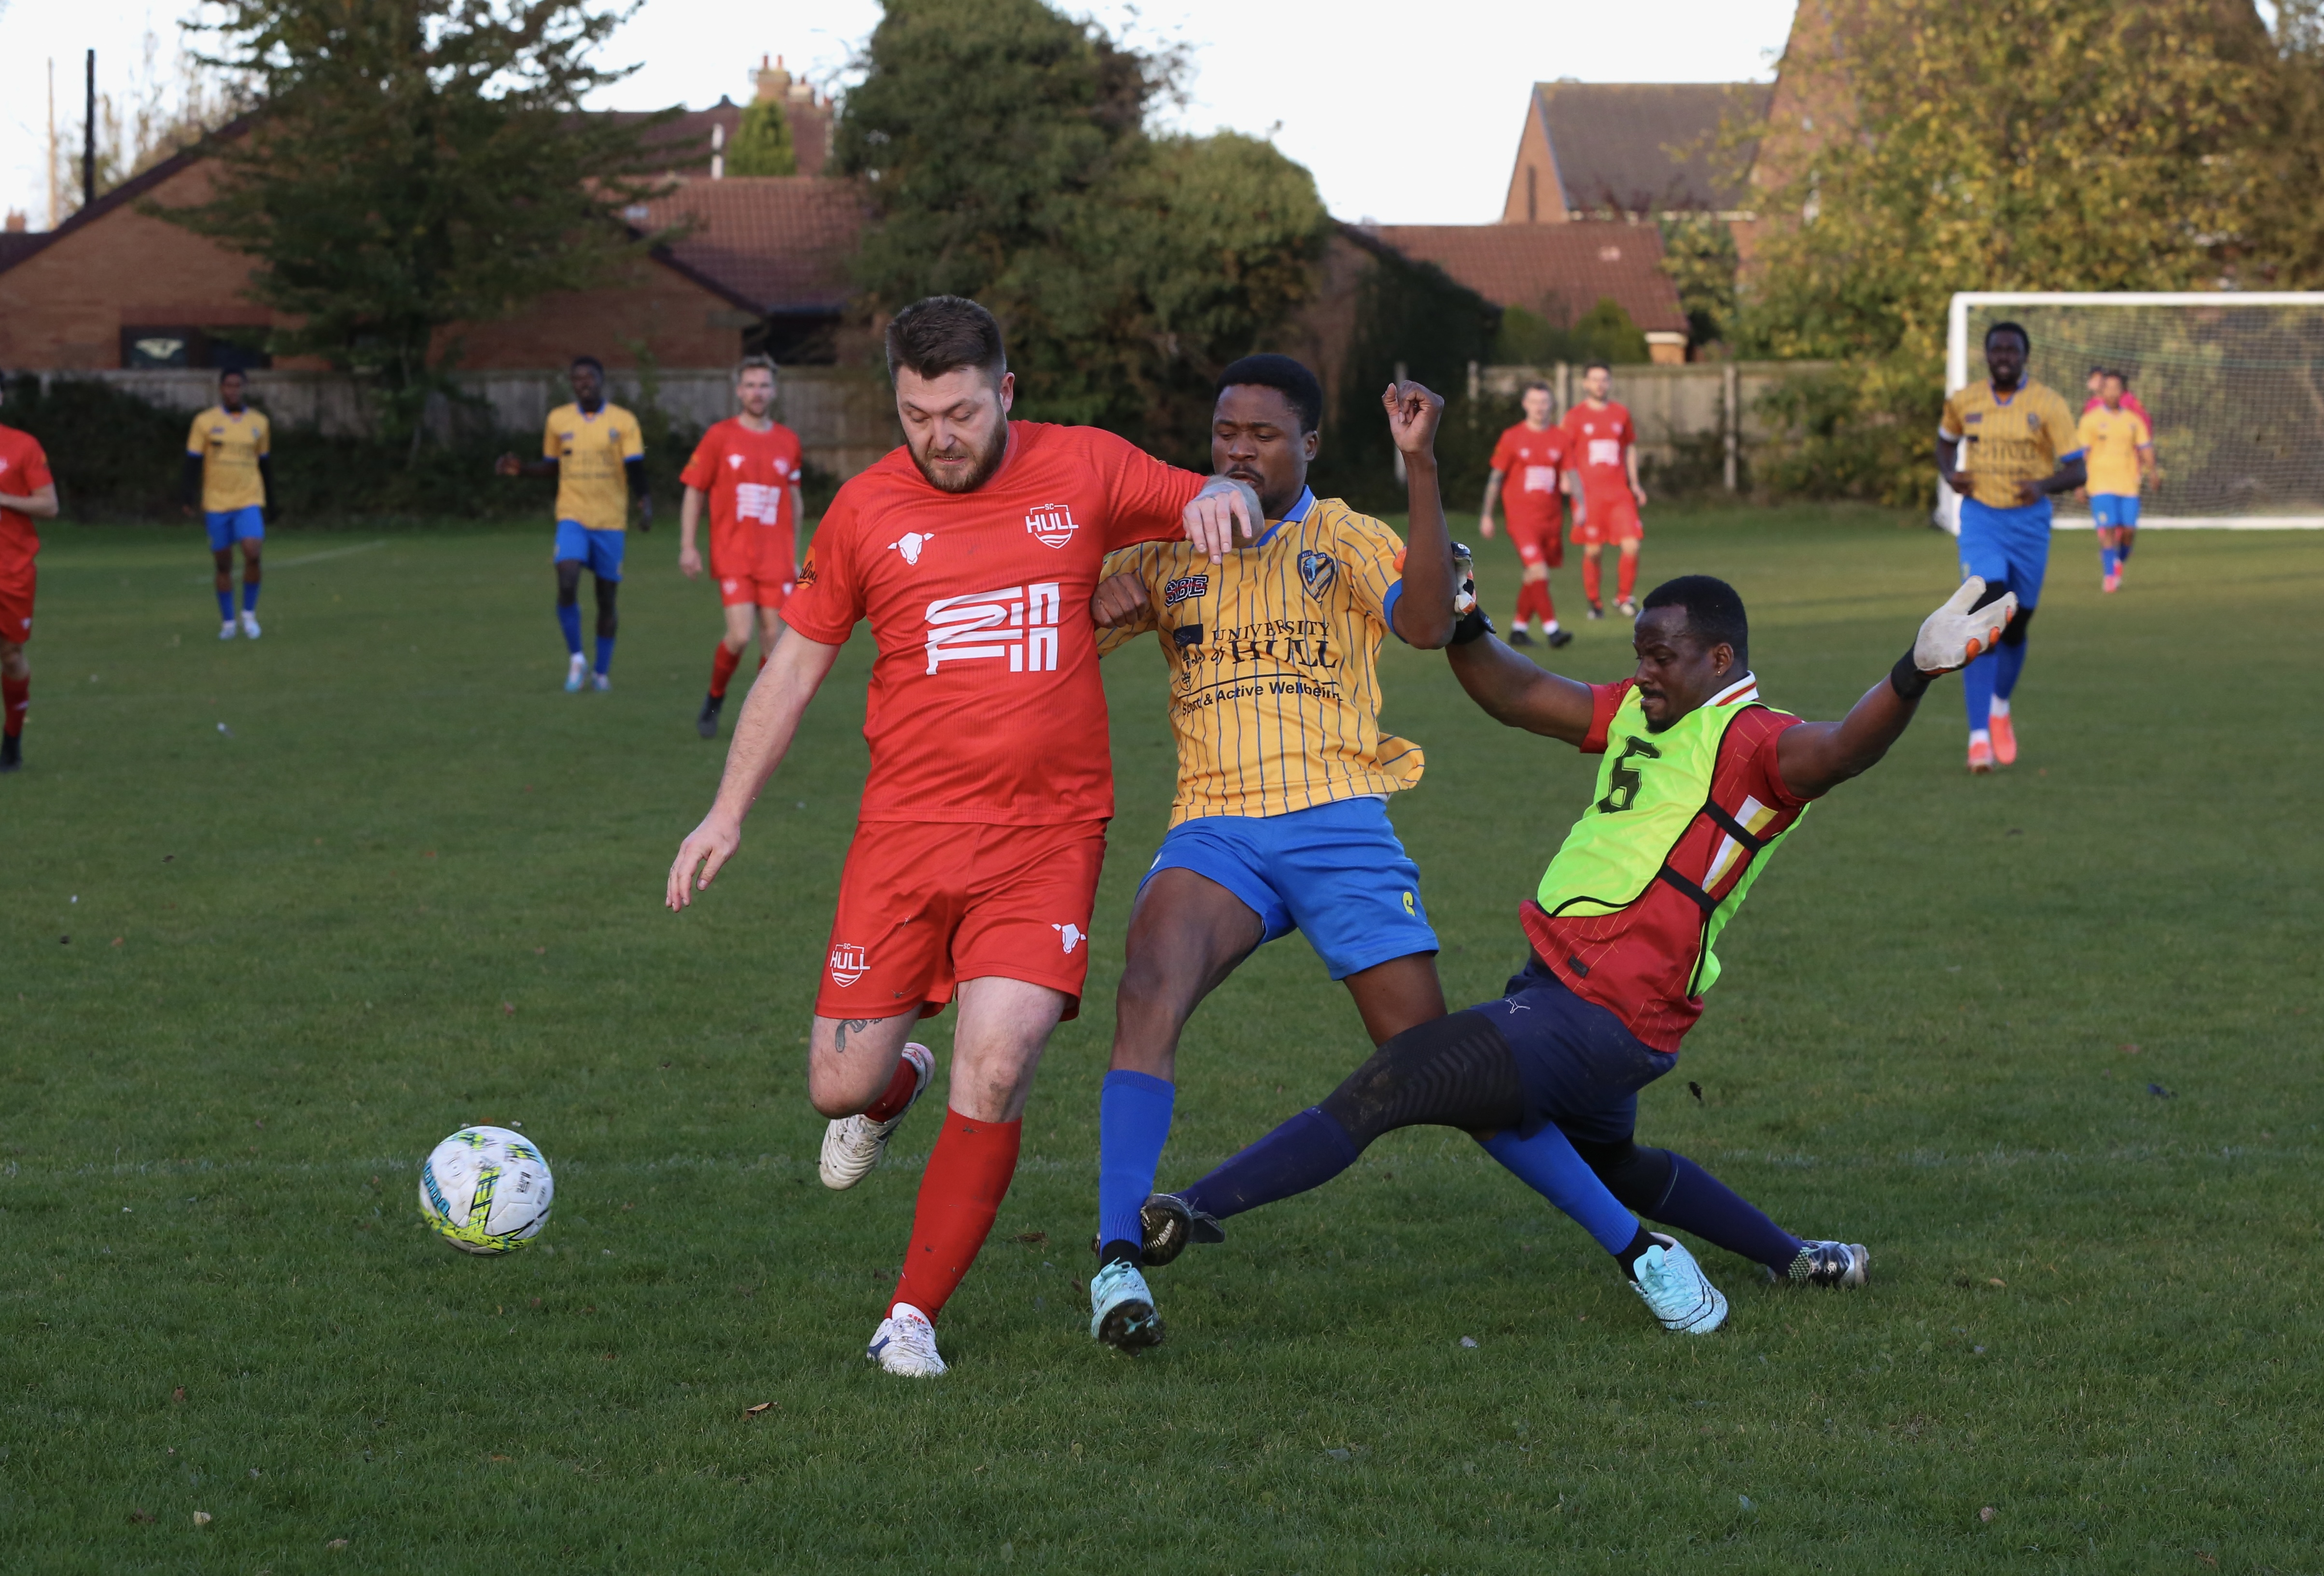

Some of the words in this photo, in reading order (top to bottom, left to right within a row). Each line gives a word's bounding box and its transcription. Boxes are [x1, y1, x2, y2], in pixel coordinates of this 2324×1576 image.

[1025, 512, 1079, 533] HULL
[1165, 575, 1209, 607] SBE
[1211, 620, 1329, 641] UNIVERSITY
[1211, 647, 1225, 665] of
[1228, 637, 1338, 668] HULL
[1183, 697, 1202, 717] Sport
[1204, 693, 1213, 706] &
[1217, 685, 1264, 701] Active
[830, 950, 871, 970] HULL
